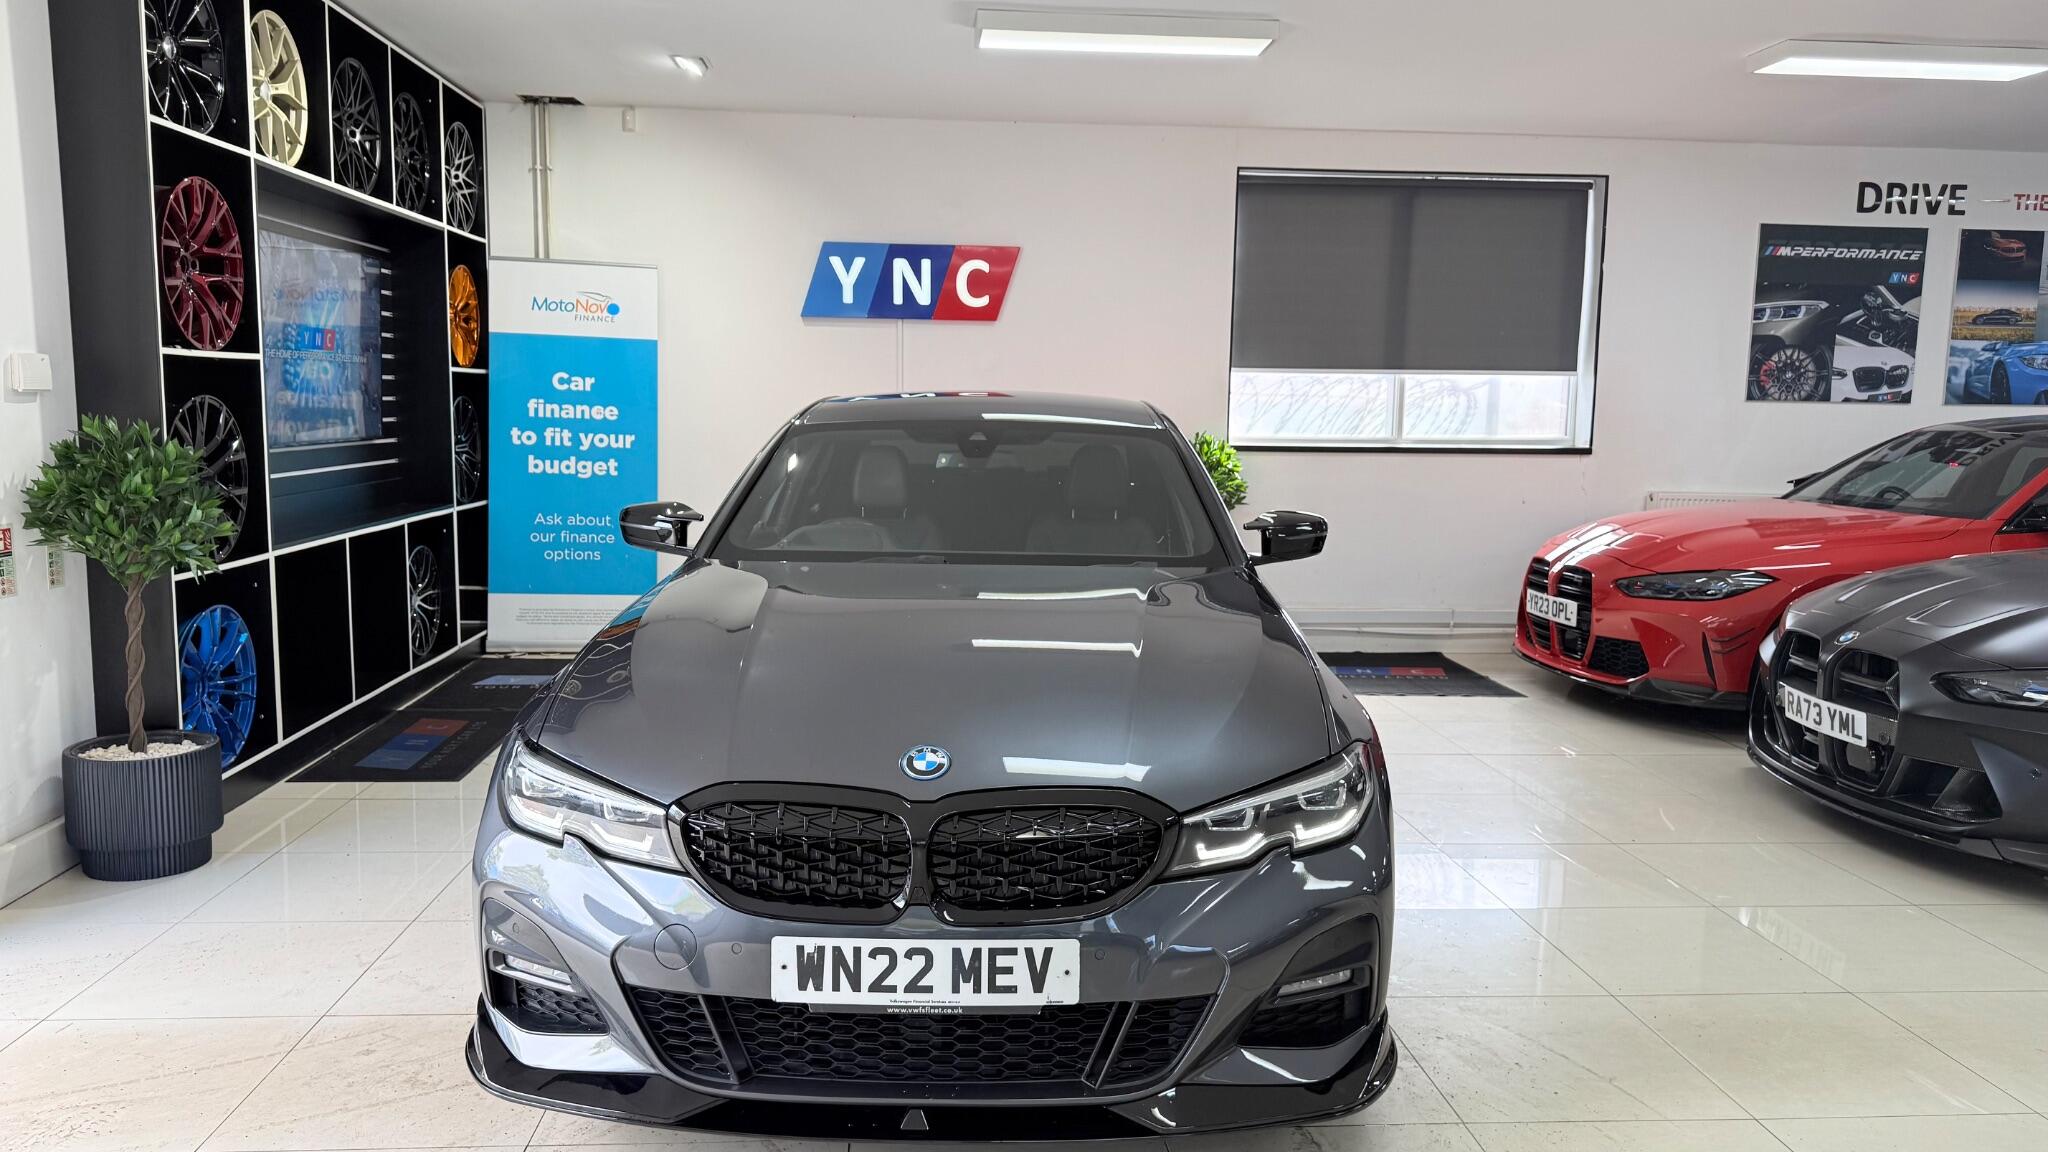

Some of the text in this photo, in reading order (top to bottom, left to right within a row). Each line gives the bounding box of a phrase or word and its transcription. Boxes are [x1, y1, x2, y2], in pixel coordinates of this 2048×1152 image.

[1856, 181, 1968, 216] DRIVE
[828, 255, 990, 308] YNC
[1893, 273, 1916, 285] YNC
[531, 296, 620, 315] MotoNovo
[574, 313, 616, 323] FINANCE
[303, 330, 332, 348] YNC
[552, 371, 595, 391] Car
[527, 398, 619, 421] finance
[510, 427, 635, 451] to fit your
[528, 455, 618, 479] budget
[534, 513, 611, 527] Ask about
[530, 530, 615, 543] our finance
[544, 548, 601, 562] options
[1530, 592, 1571, 622] YR23 OPL
[1787, 691, 1863, 741] RA73 YML
[796, 944, 1054, 994] WN22 MEV
